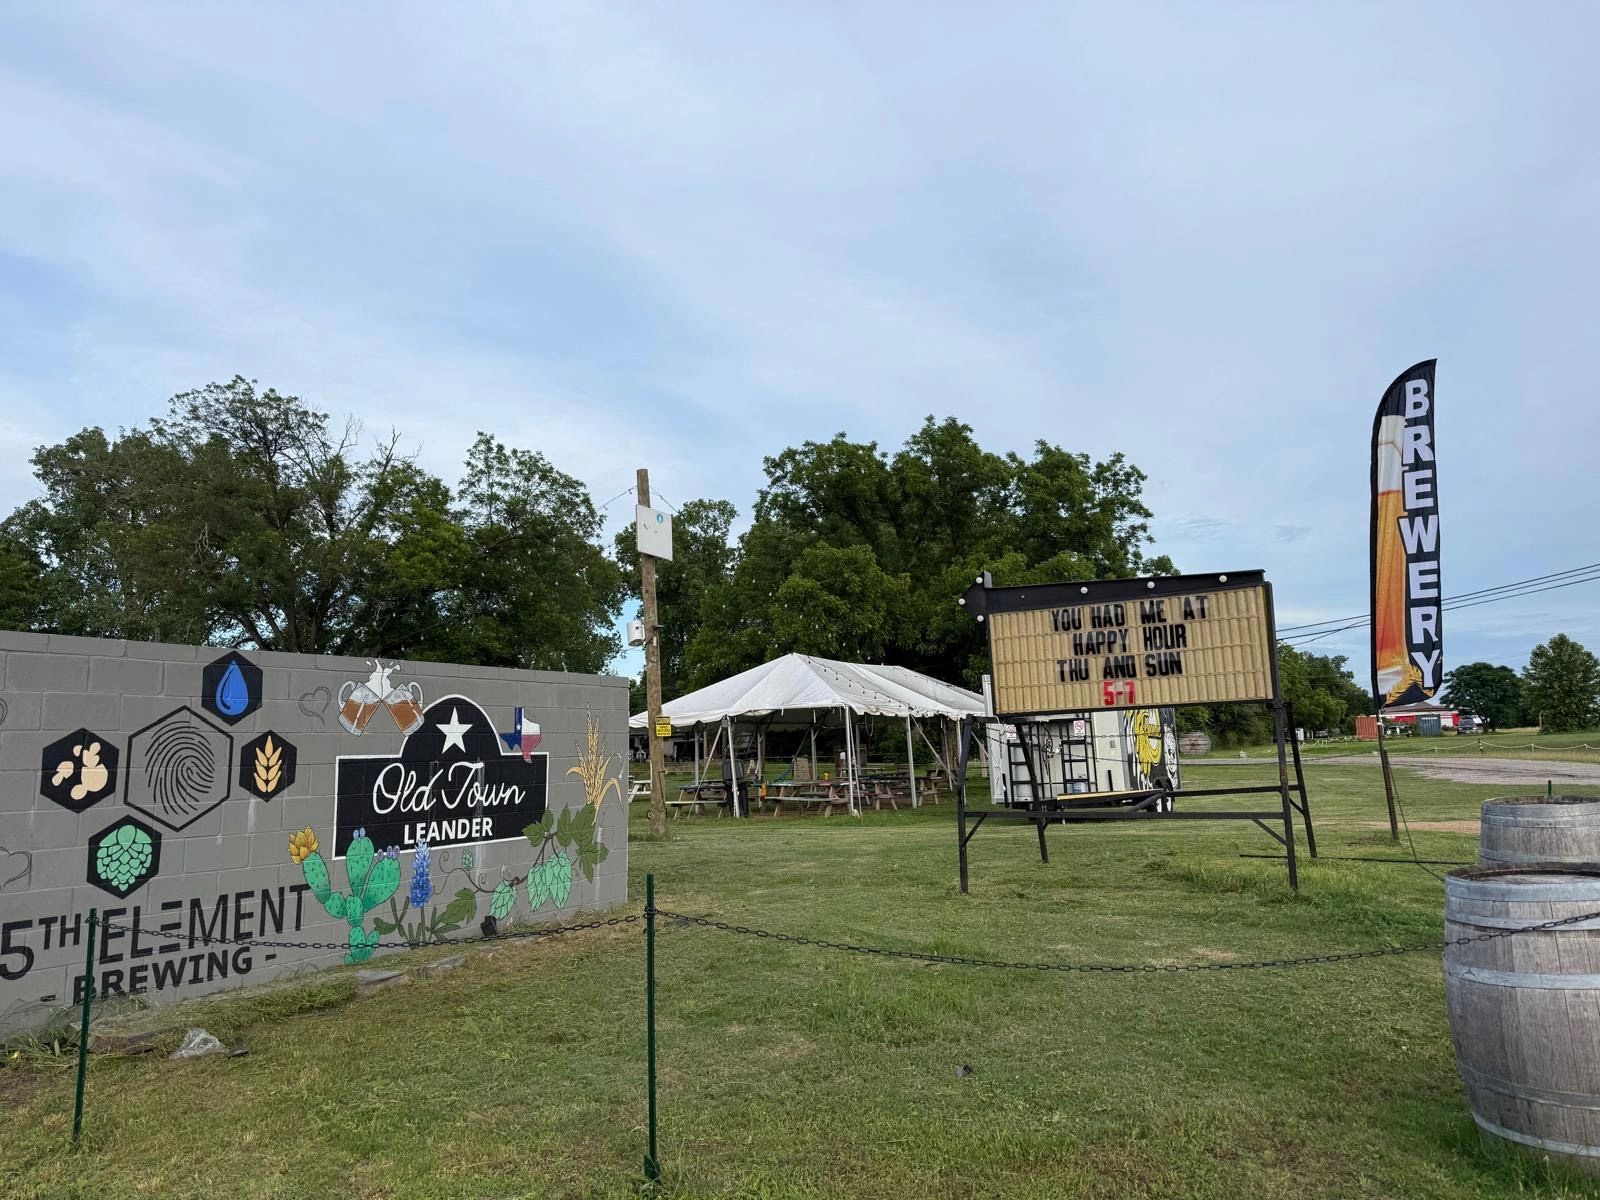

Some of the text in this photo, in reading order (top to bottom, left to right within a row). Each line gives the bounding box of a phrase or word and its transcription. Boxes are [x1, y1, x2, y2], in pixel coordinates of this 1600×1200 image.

[1398, 378, 1441, 689] BREWERY
[1051, 595, 1209, 632] YOU HAD ME AT
[1073, 623, 1187, 656] HAPPY HOUR
[1057, 651, 1182, 682] THU AND SUN
[1103, 680, 1135, 706] 5-7
[373, 761, 526, 814] Old Town
[403, 817, 493, 845] LEANDER
[0, 884, 311, 980] 5TH ELEMENT
[72, 946, 252, 1006] BREWING
